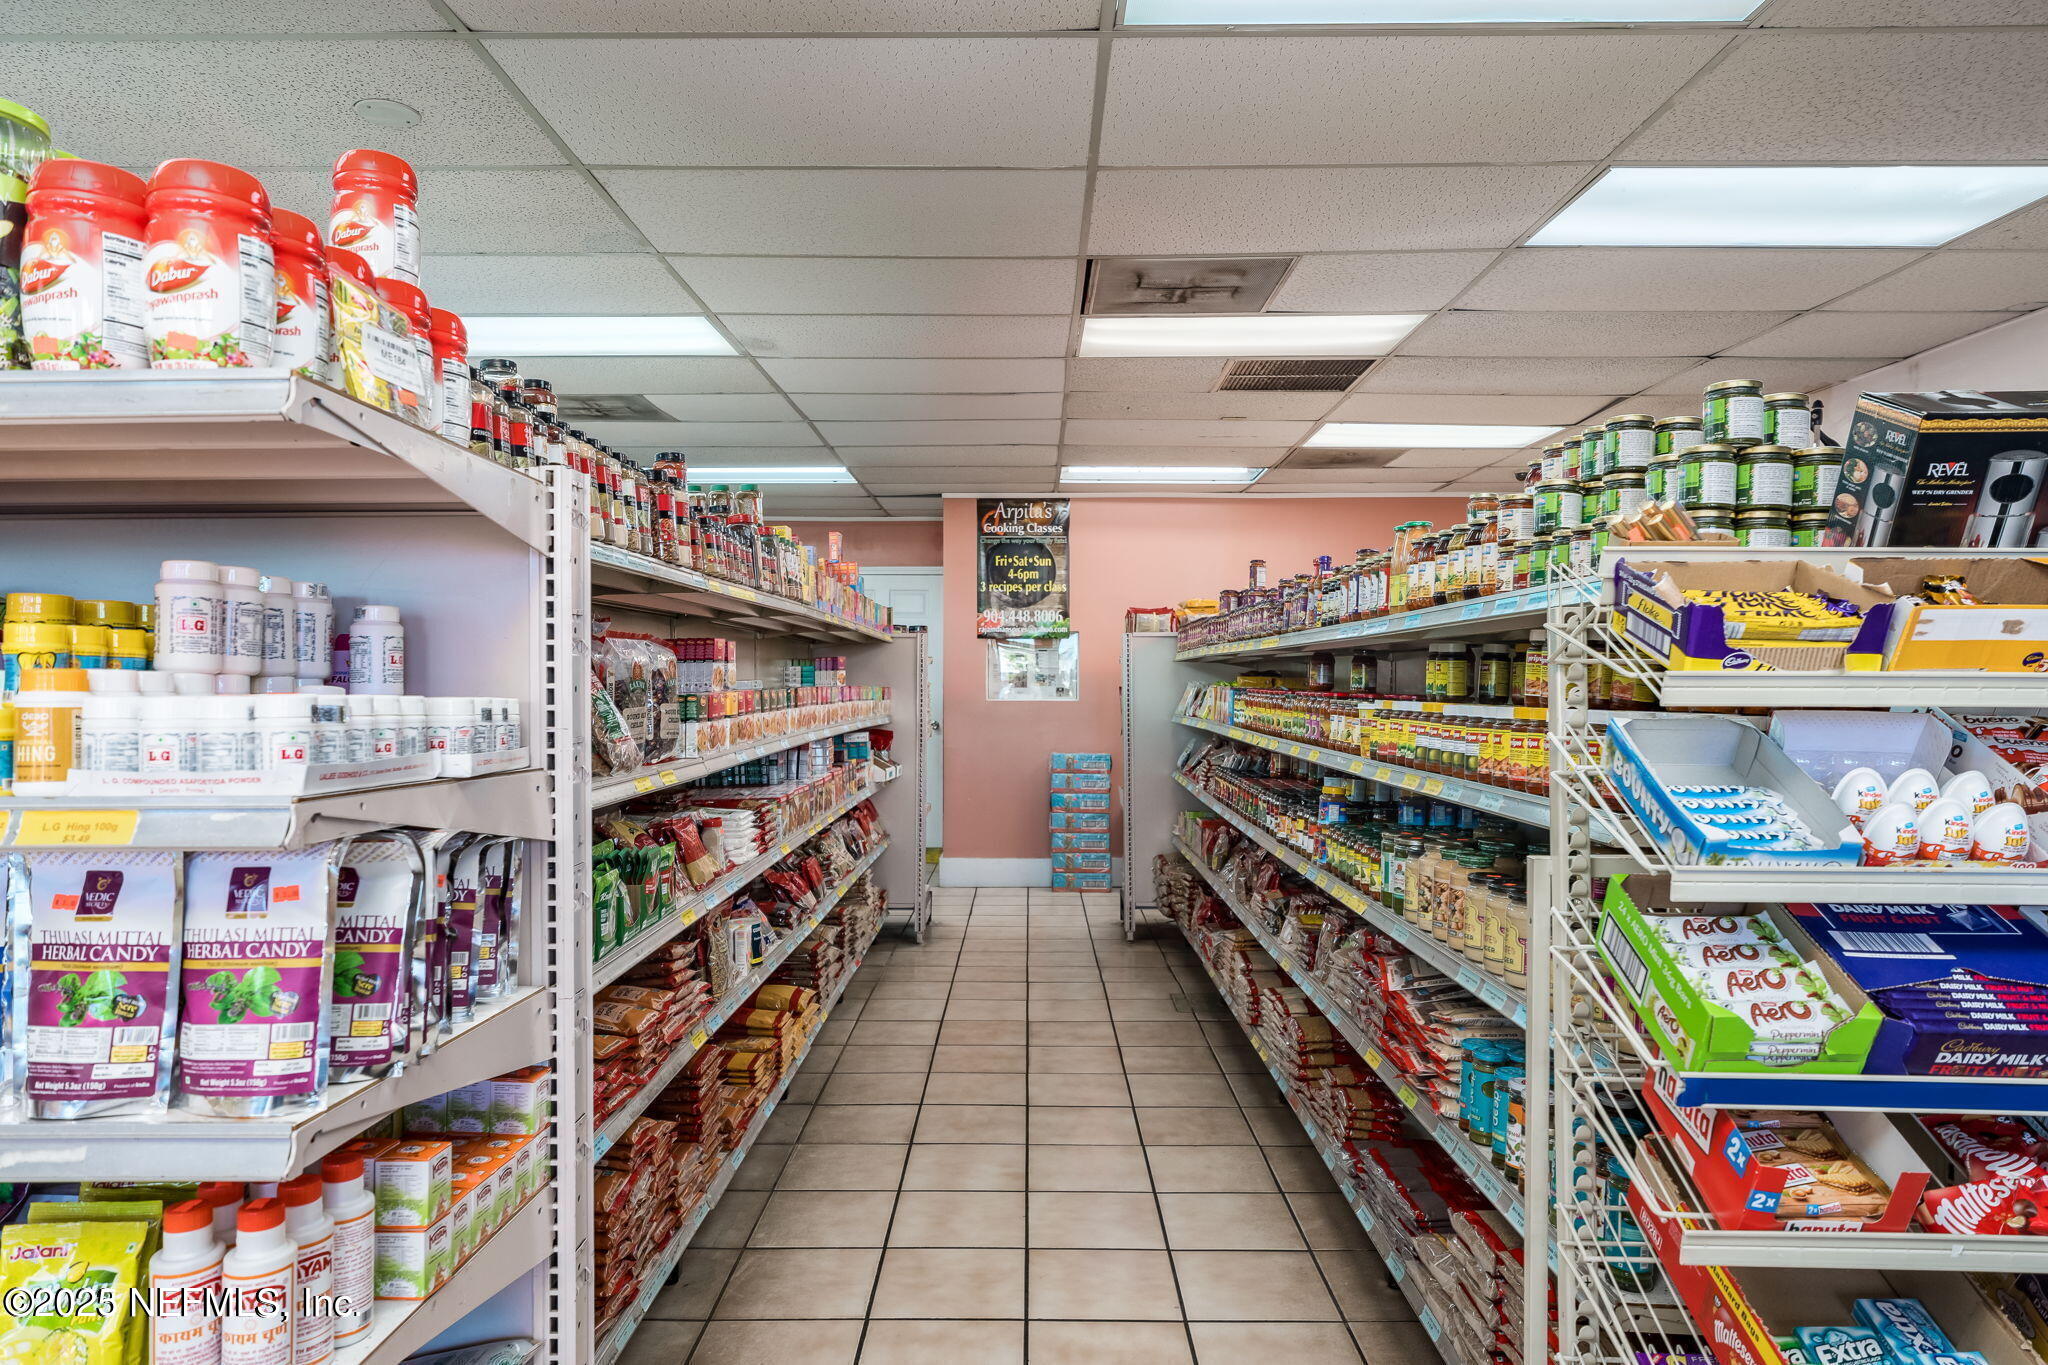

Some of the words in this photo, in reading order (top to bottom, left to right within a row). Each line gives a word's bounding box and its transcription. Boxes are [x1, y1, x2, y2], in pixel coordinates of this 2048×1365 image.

[335, 226, 365, 242] Dabur
[22, 266, 57, 287] Dabur
[151, 266, 199, 287] Dabur
[994, 501, 1052, 524] Arpita's
[984, 523, 1024, 535] Cooking
[1027, 523, 1063, 533] Classes
[1008, 569, 1039, 582] 4-6pm
[980, 582, 986, 592] 3
[989, 580, 1022, 595] recipes
[1025, 584, 1041, 595] per
[1044, 580, 1067, 592] class
[984, 610, 1063, 622] 904.448.8006
[1963, 715, 2020, 723] bueno
[1993, 737, 2048, 745] bueno
[17, 745, 56, 762] HING
[1614, 751, 1669, 834] BOUNTY
[1693, 815, 1773, 824] OUNTY
[66, 822, 90, 832] Hing
[94, 823, 118, 832] 100g
[1727, 831, 1787, 840] UNTY
[338, 882, 354, 891] DIC
[86, 892, 115, 901] VEDIC
[1828, 904, 1885, 914] DAIRY
[1885, 904, 1935, 915] MILK
[339, 915, 398, 928] MITTAI
[1840, 914, 1888, 924] FRUIT
[1892, 915, 1900, 924] &
[1902, 916, 1942, 924] NUT
[40, 930, 92, 945] THULASI
[96, 931, 163, 945] MITTAI
[184, 928, 248, 943] THULASI
[252, 926, 315, 941] MITTAI
[335, 929, 395, 943] CANDY
[41, 945, 88, 960] HERBAL
[90, 945, 160, 962] CANDY
[187, 943, 242, 959] HERBAL
[246, 942, 313, 958] CANDY
[1939, 983, 1963, 991] DAIRY
[1964, 983, 1984, 991] MILK
[1951, 992, 1975, 1000] DAIRY
[1961, 1001, 1984, 1009] DAIRY
[1970, 1012, 1994, 1020] DAIRY
[1983, 1022, 2007, 1030] DAIRY
[2008, 1023, 2030, 1031] MILK
[1770, 1030, 1824, 1040] Peppermint
[1941, 1039, 2001, 1053] Cadbury
[1934, 1052, 1998, 1064] DAIRY
[1999, 1053, 2047, 1066] MILK
[1984, 1066, 1998, 1076] &
[45, 1082, 64, 1091] Weight
[210, 1078, 230, 1087] Weight
[1727, 1137, 1746, 1168] 2x
[1751, 1193, 1776, 1208] 2x
[1807, 1205, 1818, 1215] 2x
[1819, 1203, 1842, 1214] hanuta
[1740, 1311, 1760, 1342] Bags
[1815, 1337, 1884, 1364] Extra
